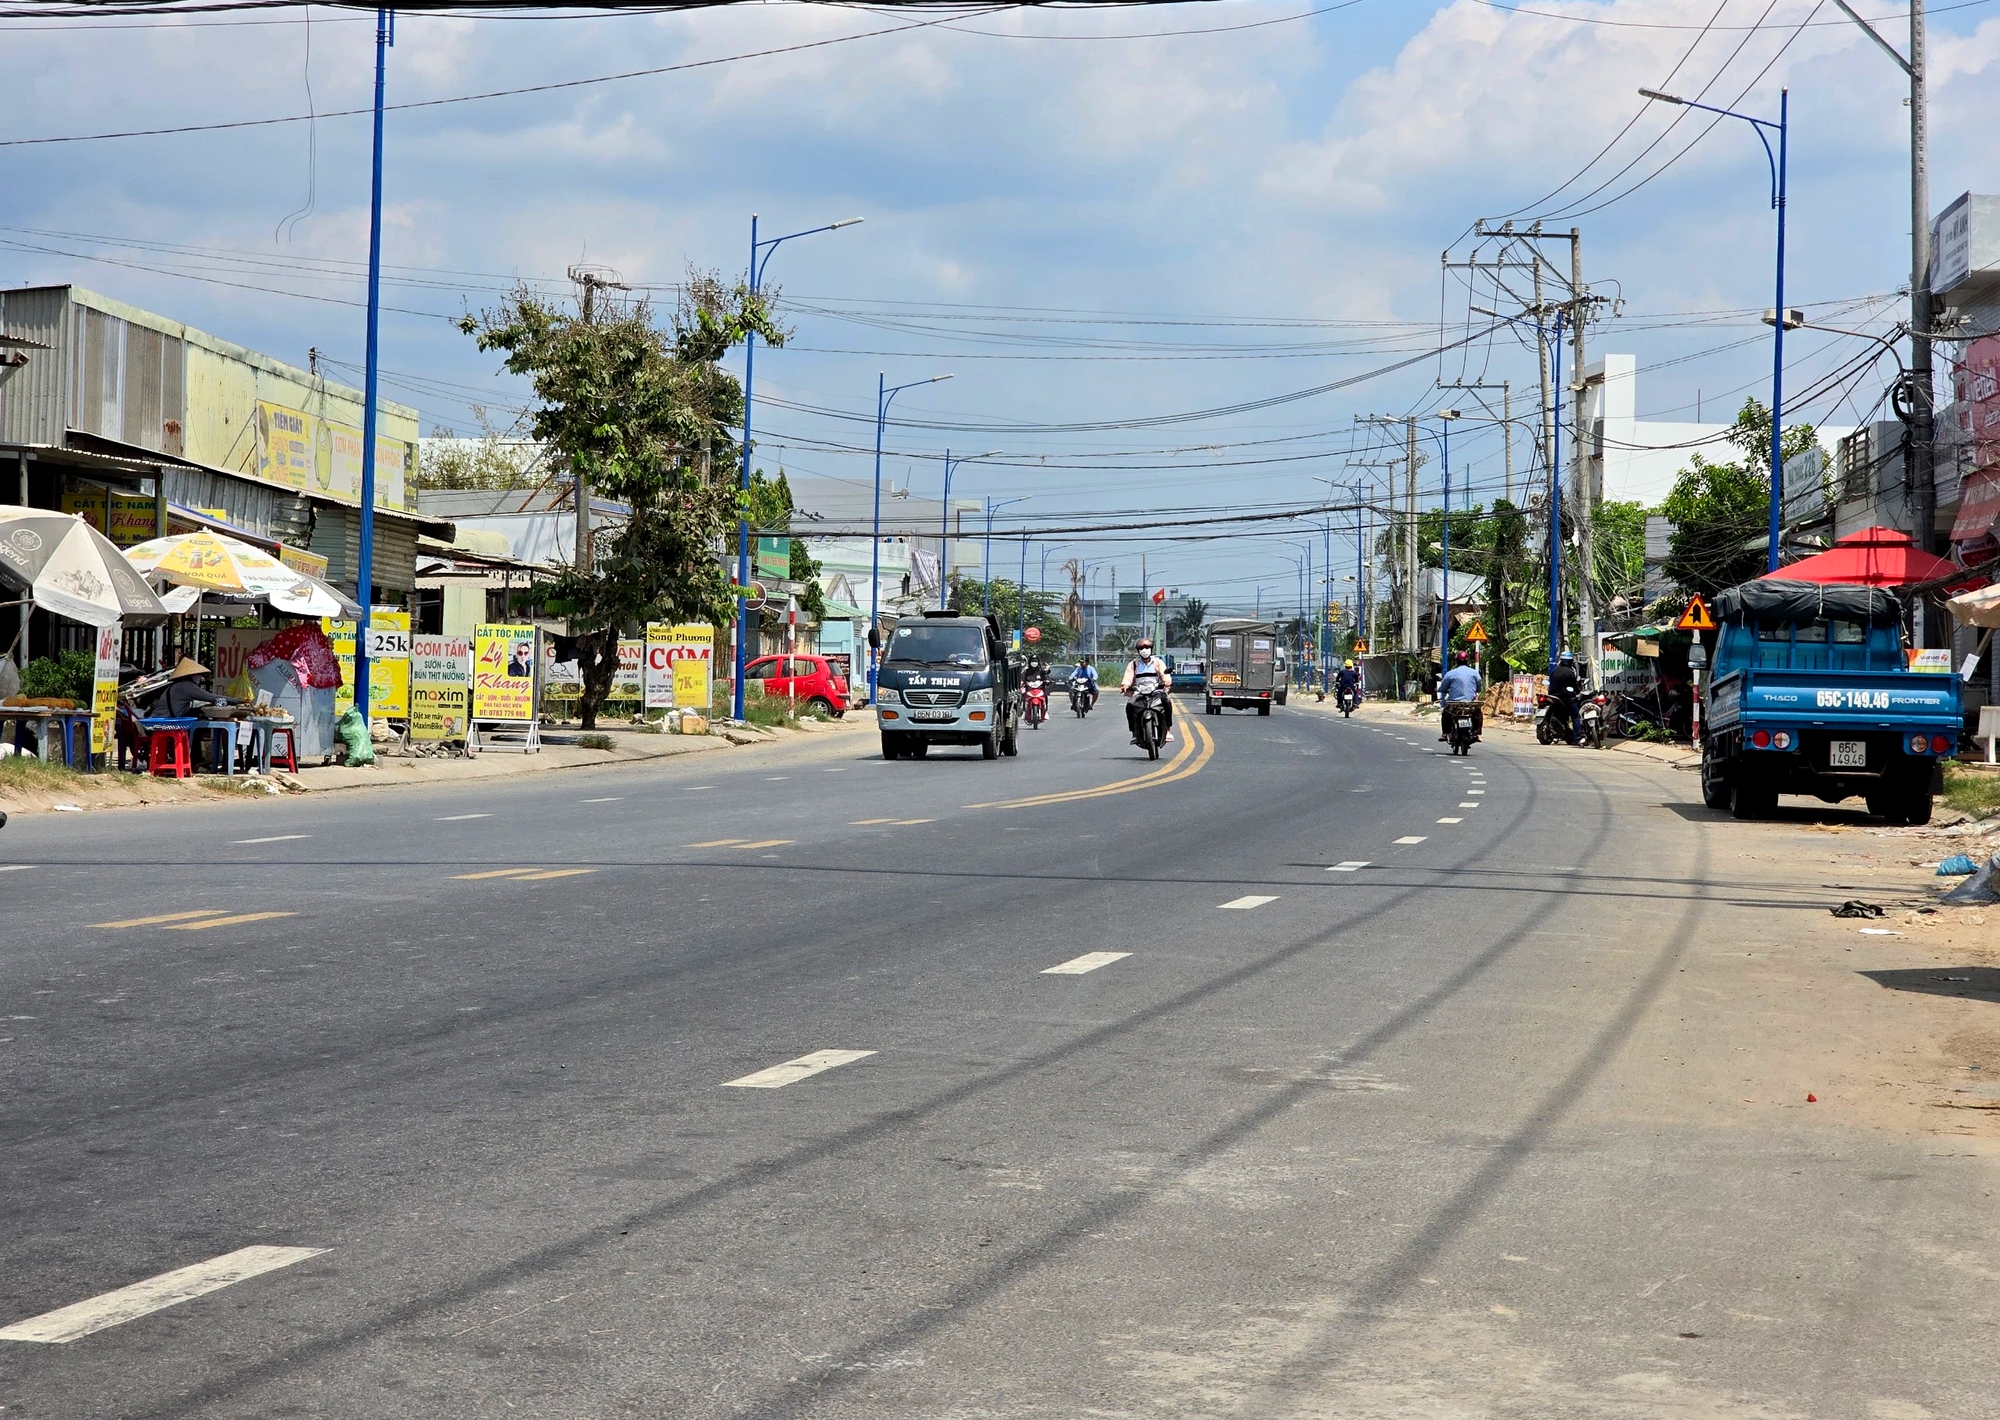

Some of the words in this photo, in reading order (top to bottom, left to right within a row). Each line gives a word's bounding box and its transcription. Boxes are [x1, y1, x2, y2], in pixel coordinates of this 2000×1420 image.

[477, 626, 494, 638] CẮT
[496, 626, 512, 639] TÓC
[514, 630, 534, 639] NAM
[649, 633, 673, 642] Song
[676, 633, 712, 643] Phương
[375, 635, 408, 652] 25k
[414, 641, 442, 657] CƠM
[445, 638, 468, 658] TẤM
[480, 641, 504, 669] Lý
[414, 670, 428, 680] BÚN
[428, 672, 441, 683] THỊT
[442, 671, 466, 681] NƯỚNG
[930, 677, 960, 688] THỊNH
[477, 673, 531, 695] Khang
[414, 687, 464, 702] maxim
[1763, 694, 1798, 702] THACO
[1816, 690, 1890, 709] 65C-149.46
[1891, 697, 1940, 705] FRONTIER
[413, 711, 424, 720] Đặt
[431, 711, 444, 721] máy
[1838, 742, 1858, 754] 65C
[1831, 753, 1865, 766] 149.46
